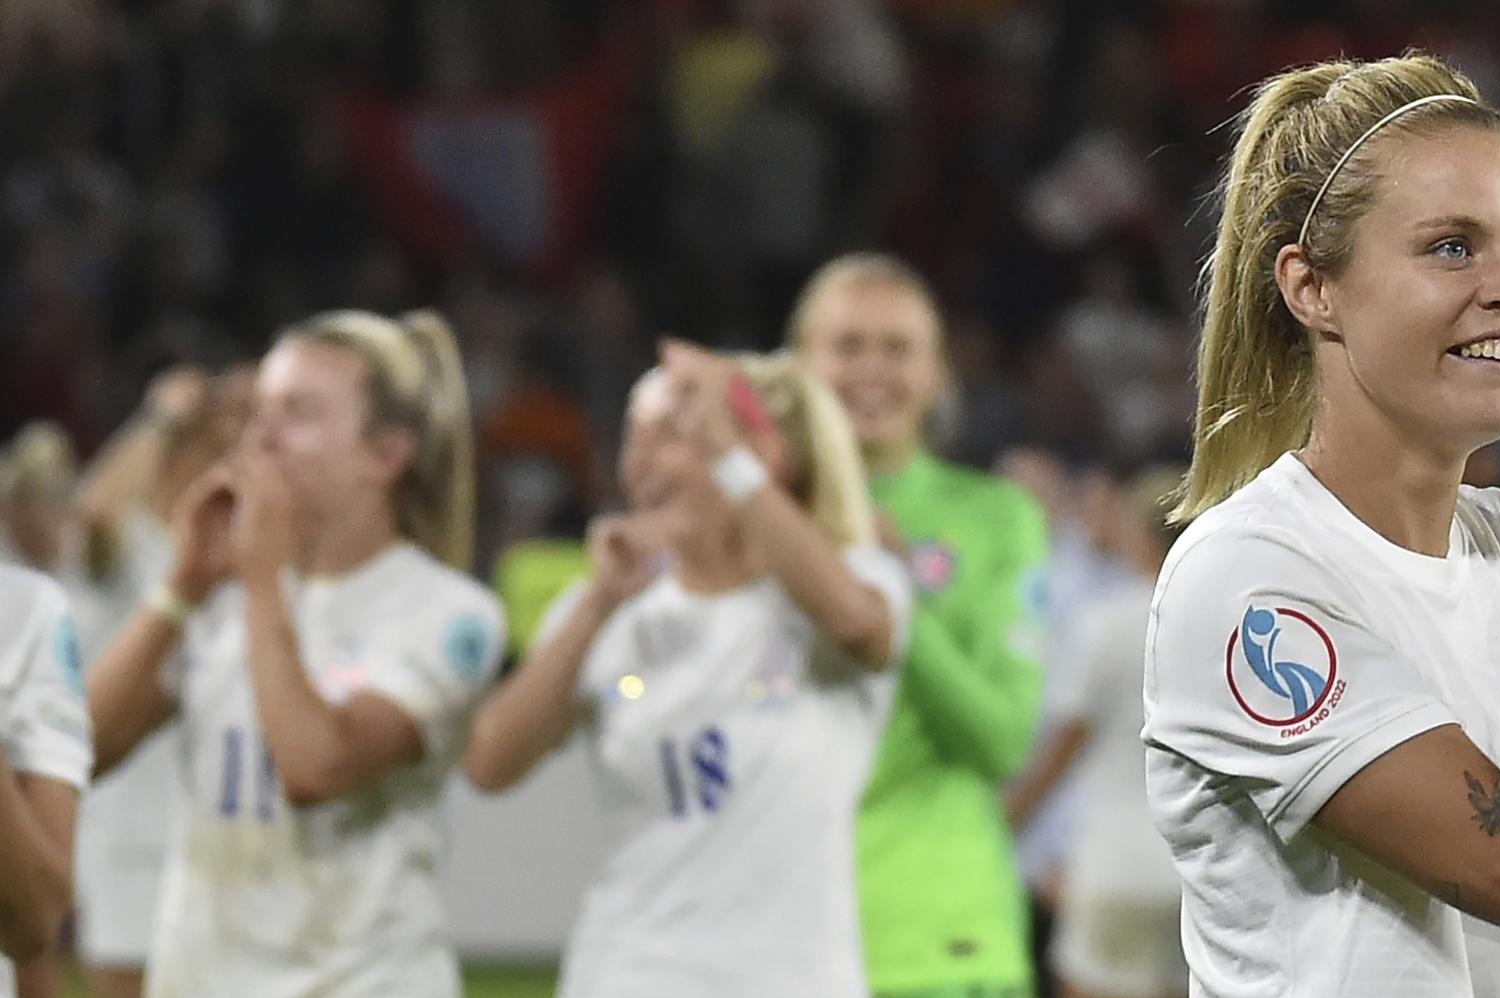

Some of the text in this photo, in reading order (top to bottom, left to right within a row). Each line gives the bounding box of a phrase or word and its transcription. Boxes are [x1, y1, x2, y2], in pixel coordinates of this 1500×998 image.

[1281, 679, 1347, 738] ENGLAND 2022
[661, 727, 734, 818] 18
